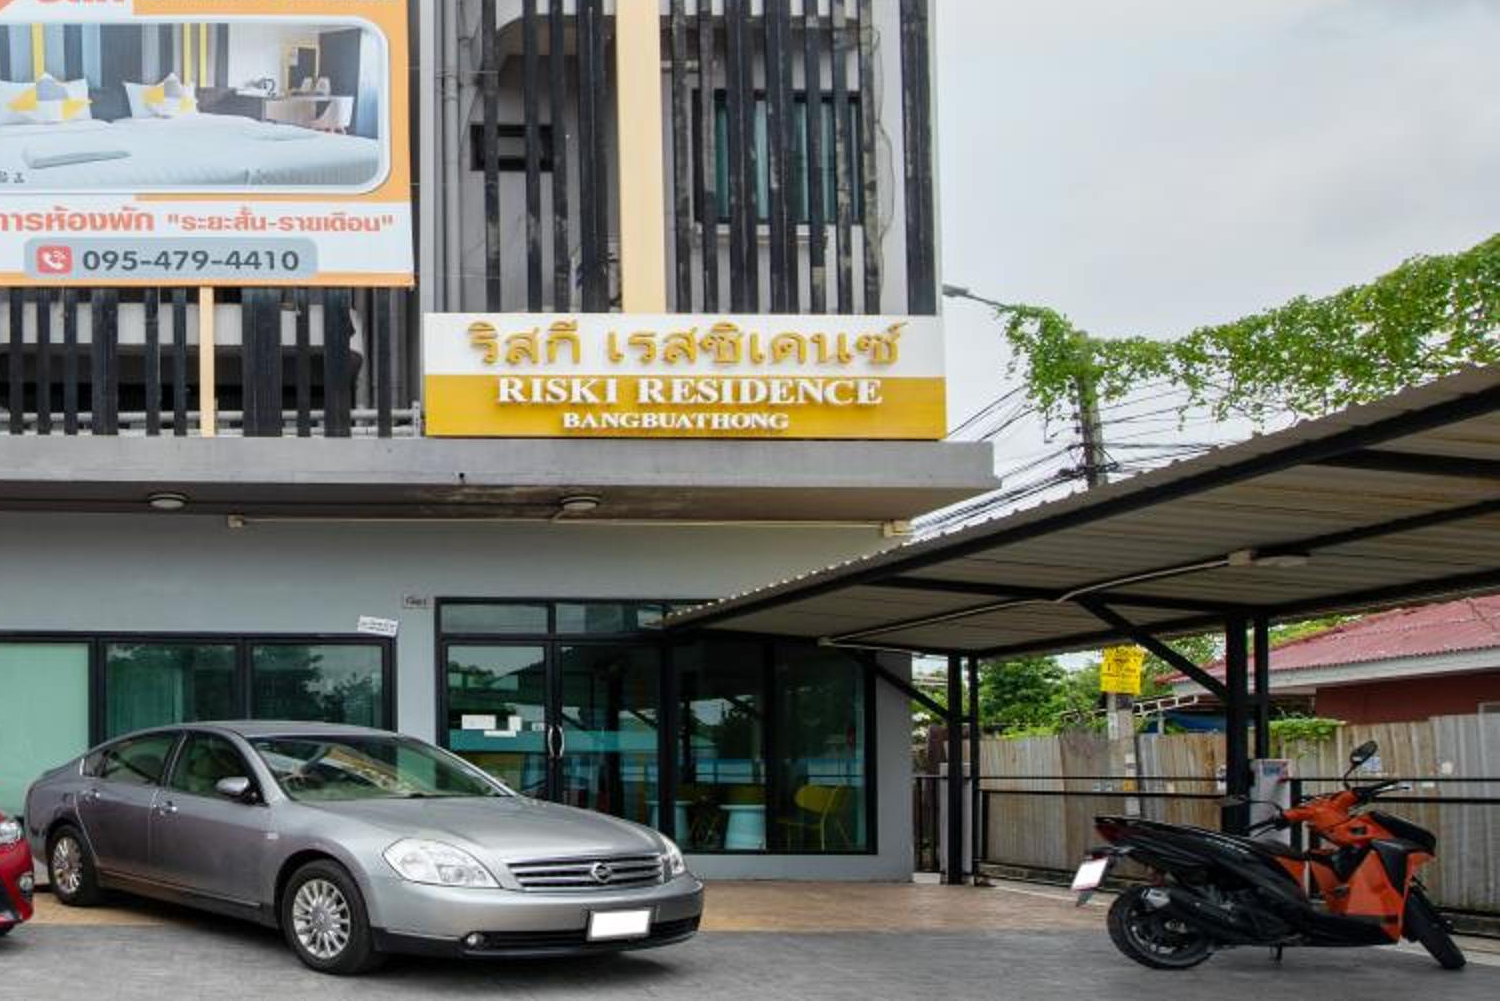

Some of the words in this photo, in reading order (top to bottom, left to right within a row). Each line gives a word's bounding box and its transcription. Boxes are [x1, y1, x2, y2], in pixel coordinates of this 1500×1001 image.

[82, 249, 301, 272] 095-479-4410
[467, 319, 583, 365] ริสกี
[497, 376, 619, 406] RISKI
[636, 377, 884, 406] RESIDENCE
[561, 411, 790, 431] BANGBUATHONG
